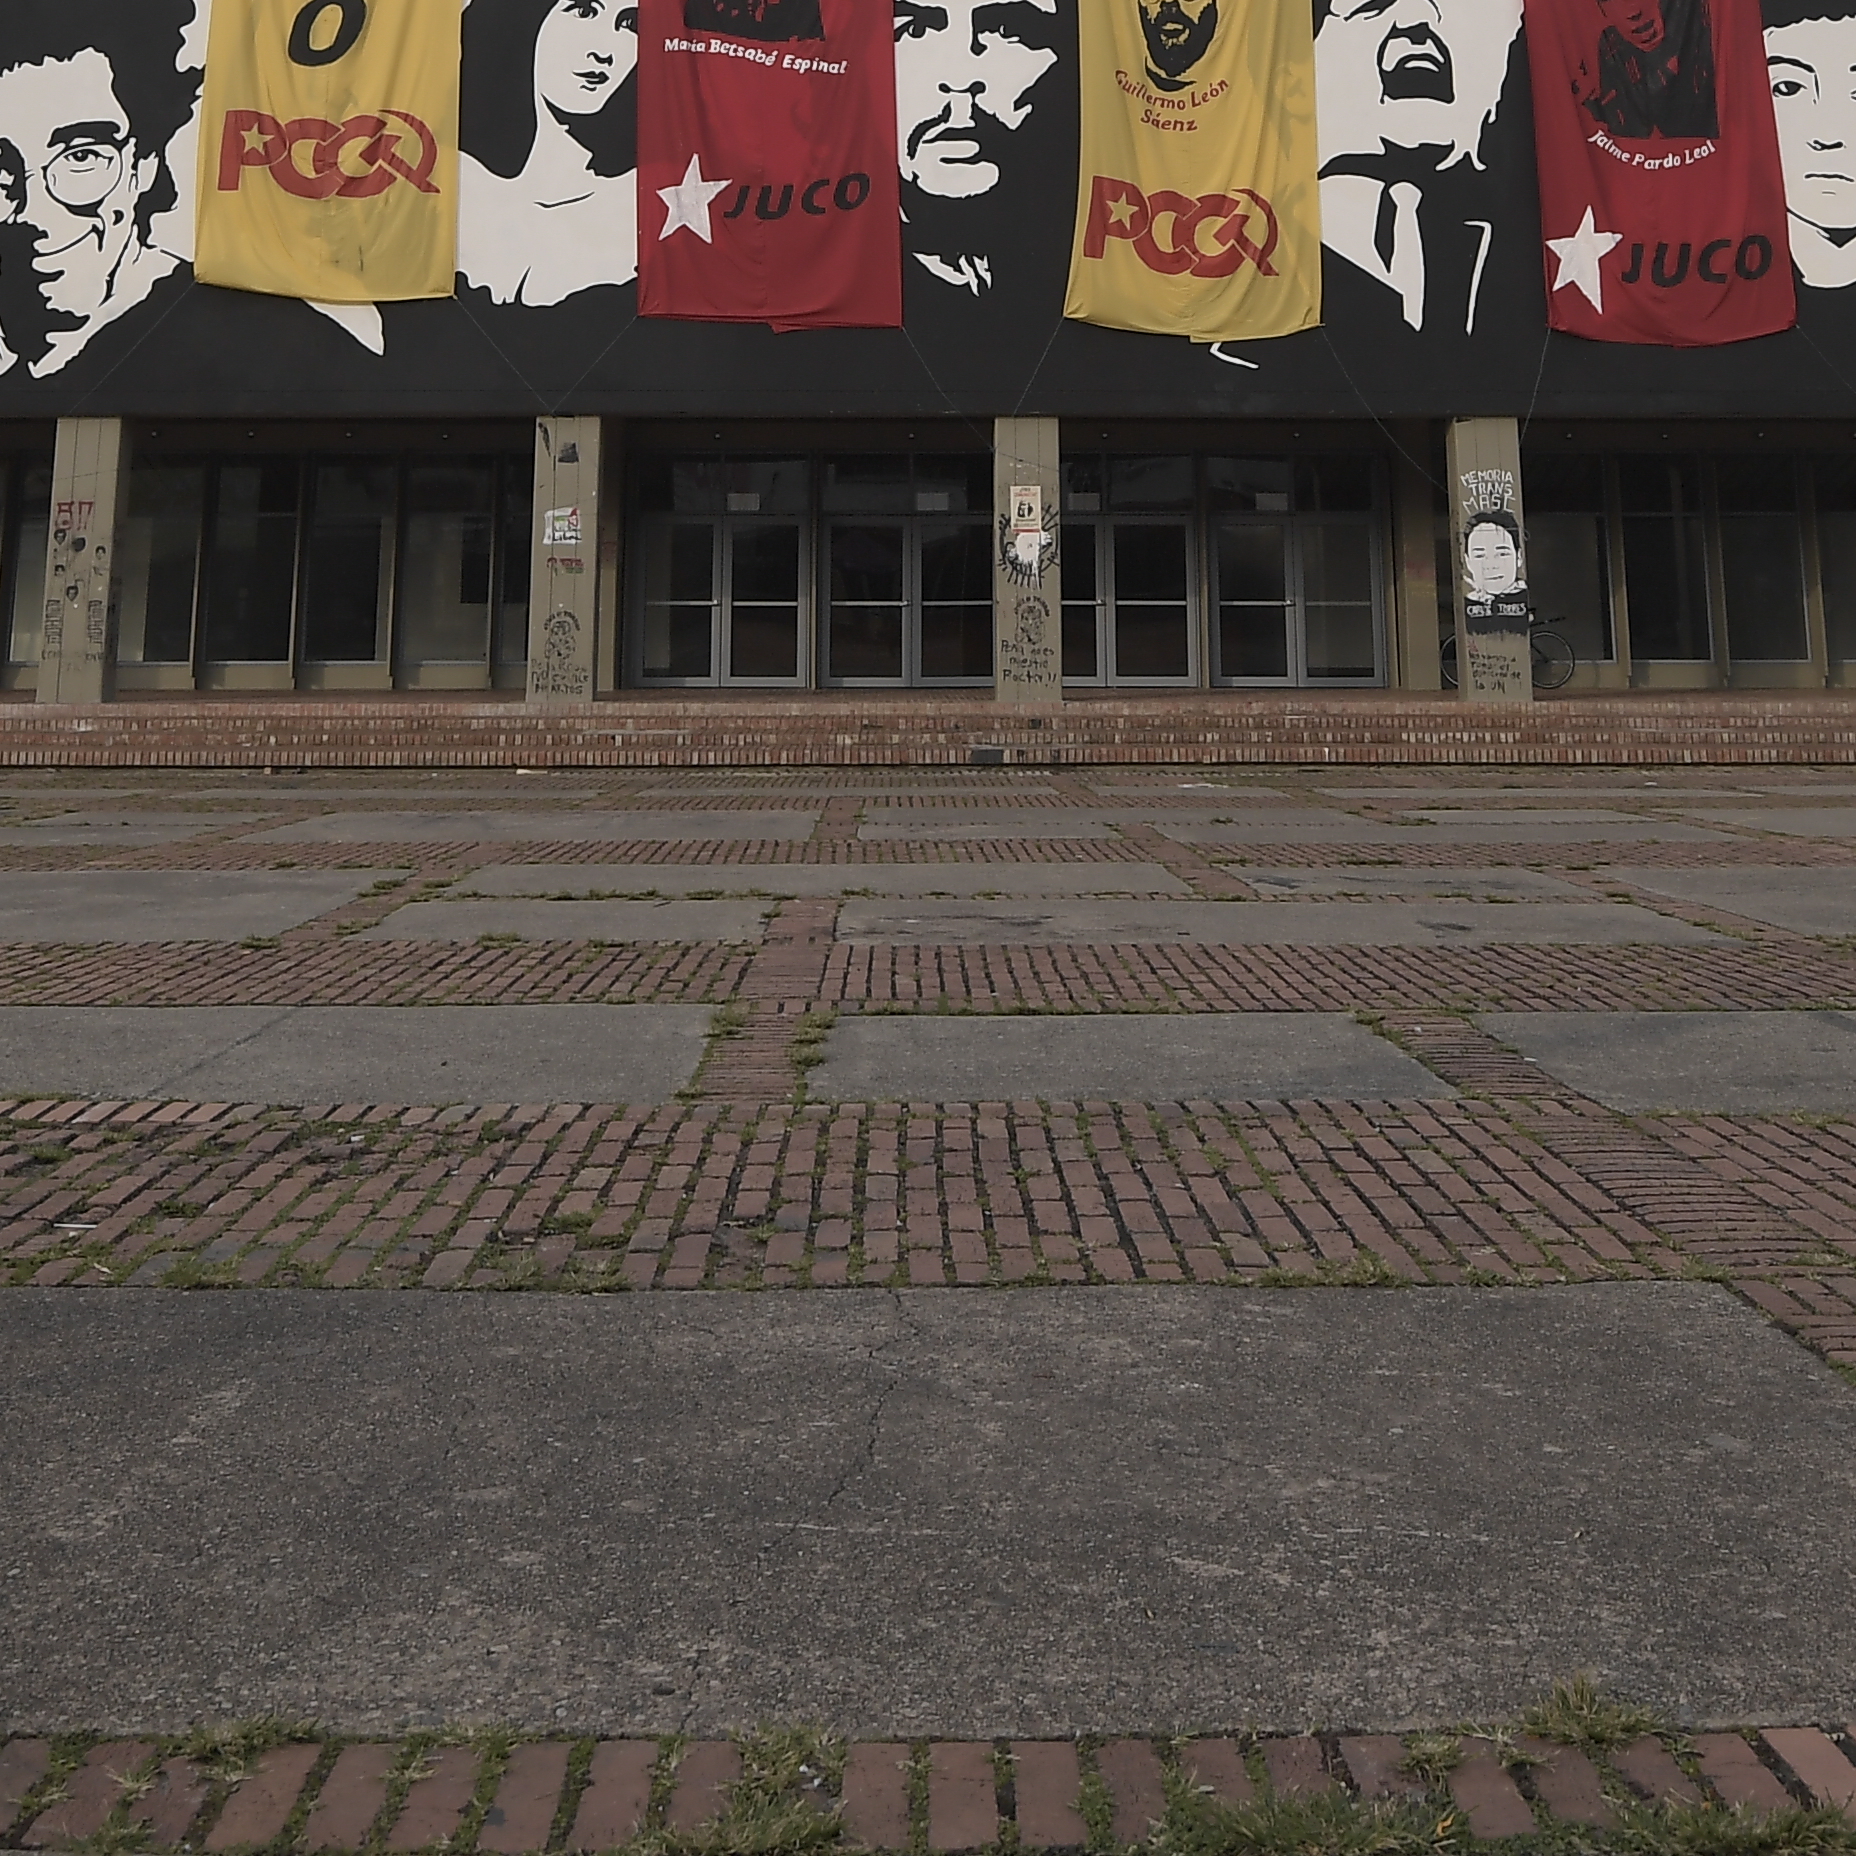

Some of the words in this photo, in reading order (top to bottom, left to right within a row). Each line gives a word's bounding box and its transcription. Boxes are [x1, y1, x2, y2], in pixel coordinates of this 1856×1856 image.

[708, 39, 779, 67] Betsabé
[782, 54, 848, 74] Espinal
[1115, 69, 1187, 110] Guillermo
[1190, 78, 1230, 108] León
[1140, 109, 1199, 132] Sáenz
[1586, 129, 1631, 163] Jaime
[1632, 152, 1681, 170] Pardo
[1684, 140, 1717, 165] Leal
[723, 172, 872, 221] JUCO
[1621, 234, 1773, 288] JUCO
[1460, 469, 1514, 486] MEMORIA
[1468, 483, 1512, 497] TRANS
[1462, 494, 1516, 515] MASC
